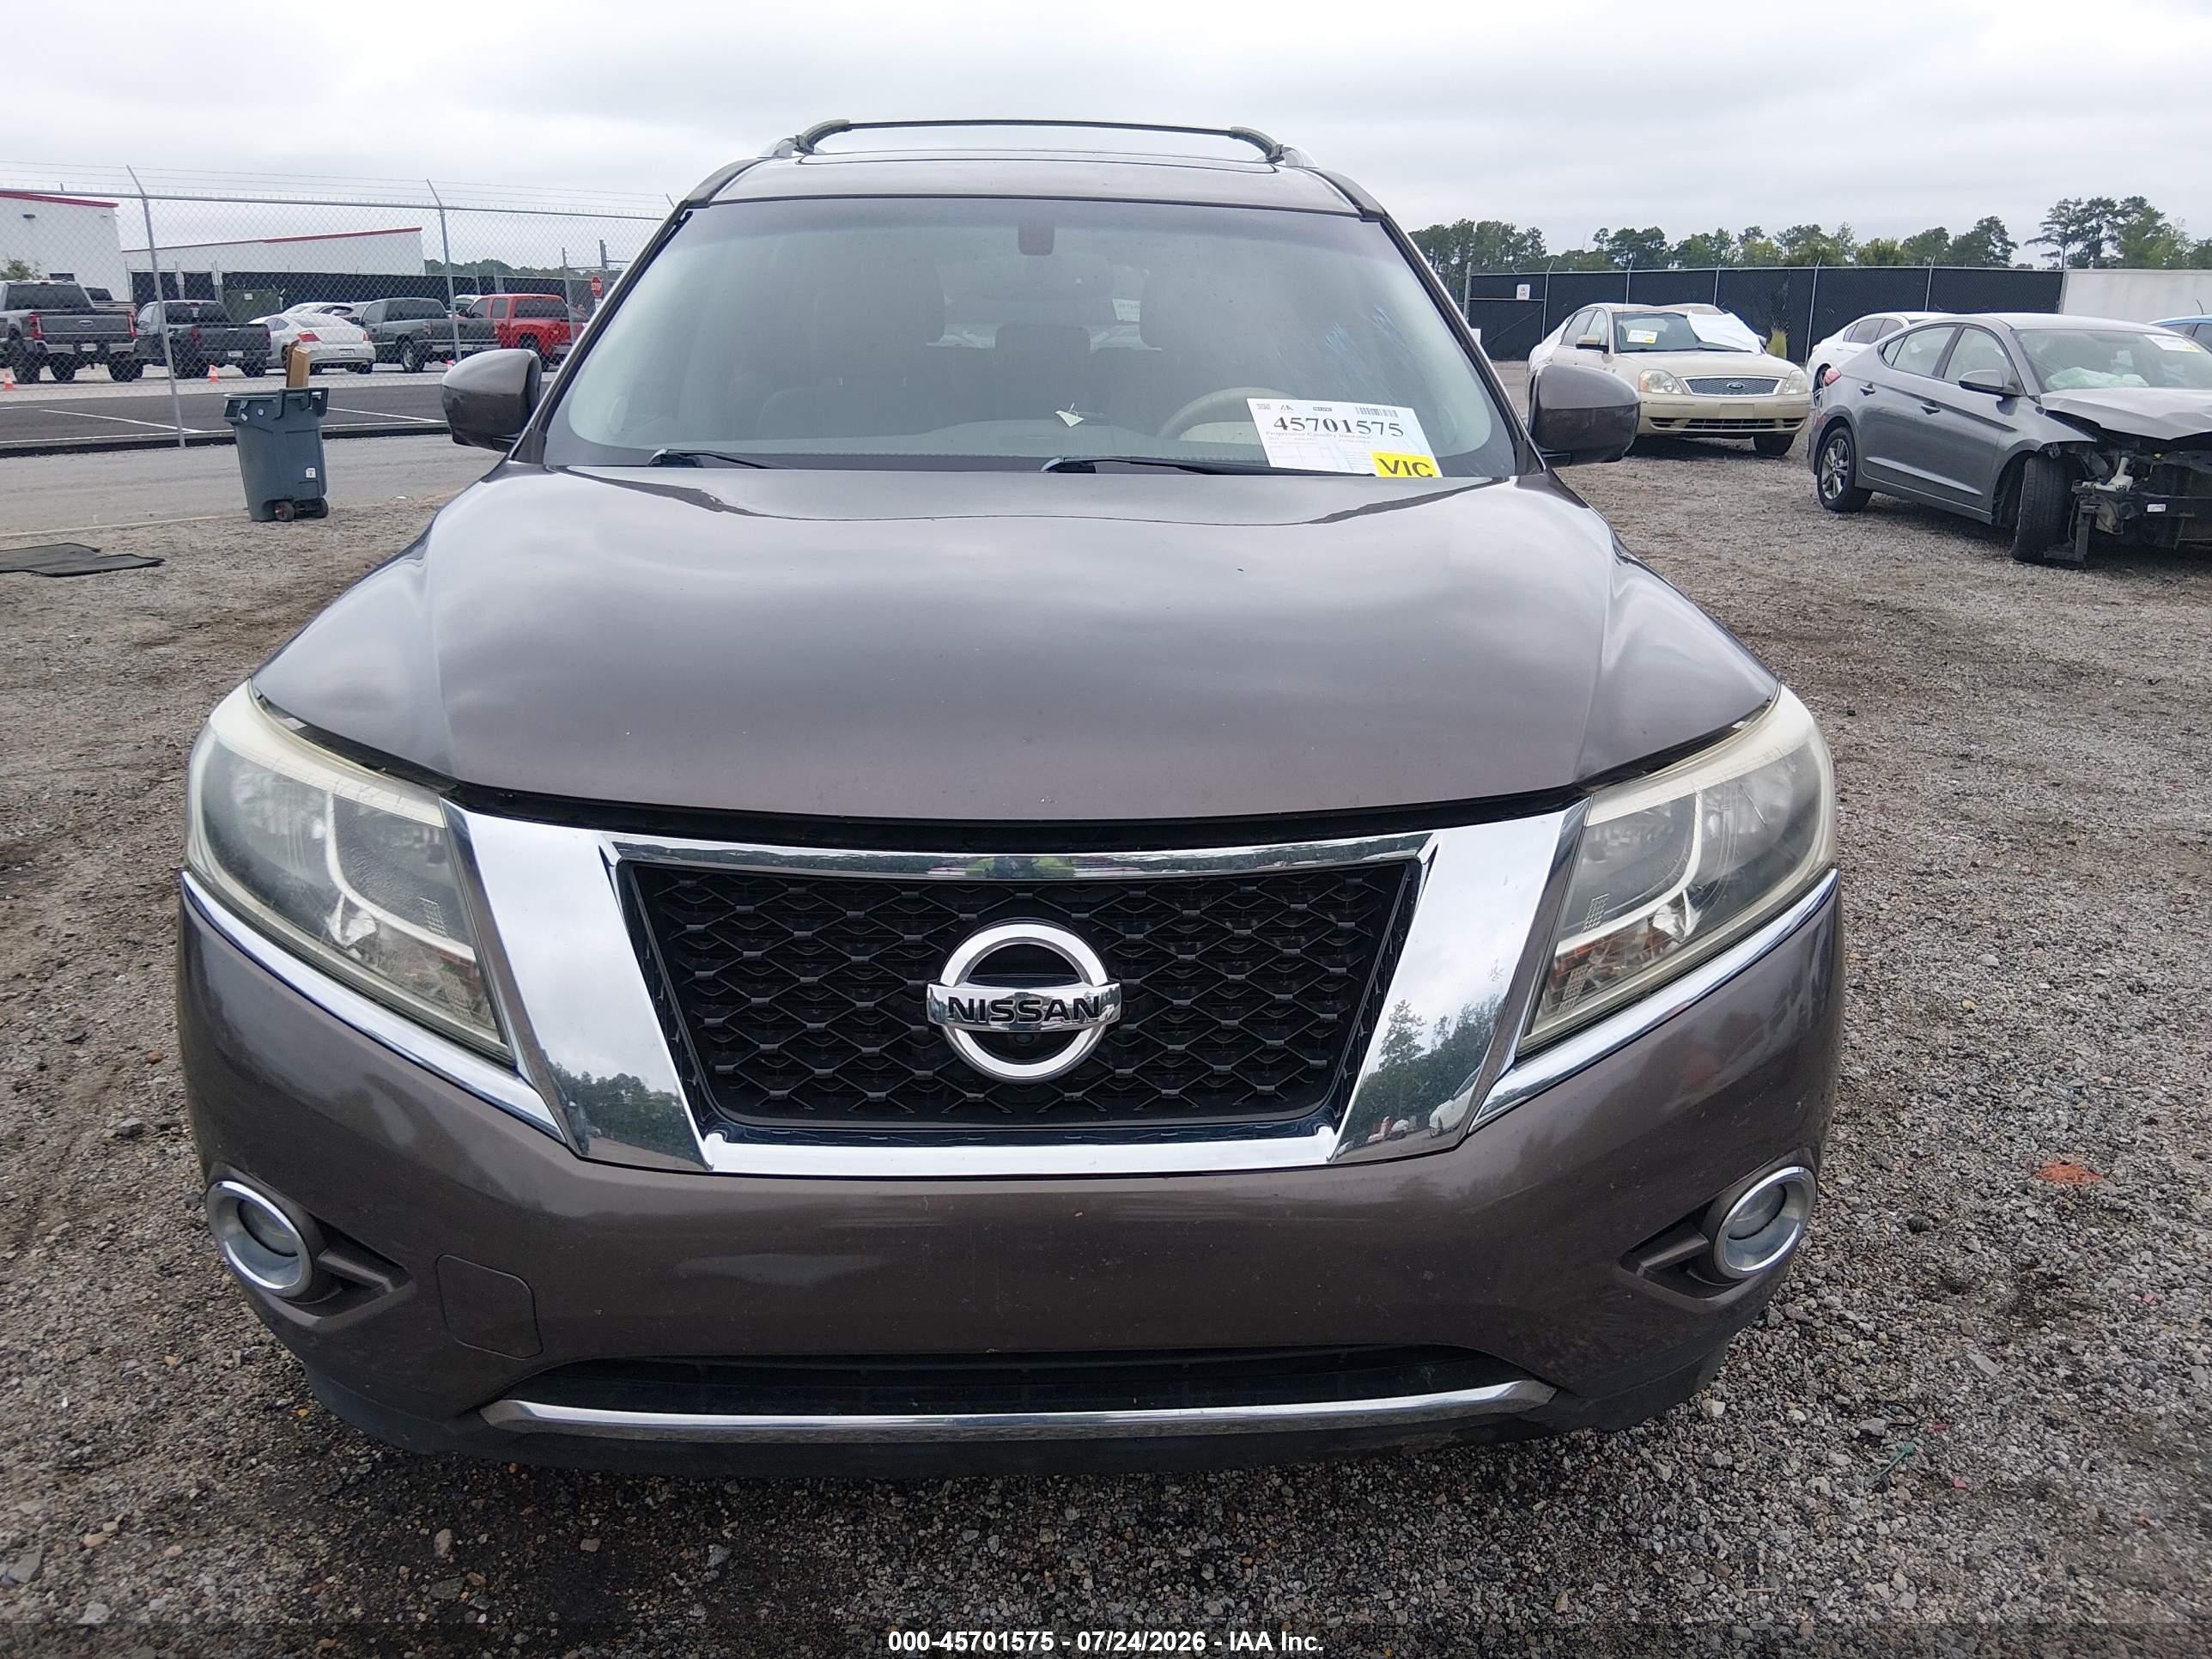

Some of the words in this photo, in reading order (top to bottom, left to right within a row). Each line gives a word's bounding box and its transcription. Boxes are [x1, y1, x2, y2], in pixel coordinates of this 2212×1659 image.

[1273, 416, 1404, 437] 45701575
[1377, 458, 1433, 477] VIC
[947, 996, 1100, 1023] NISSAN
